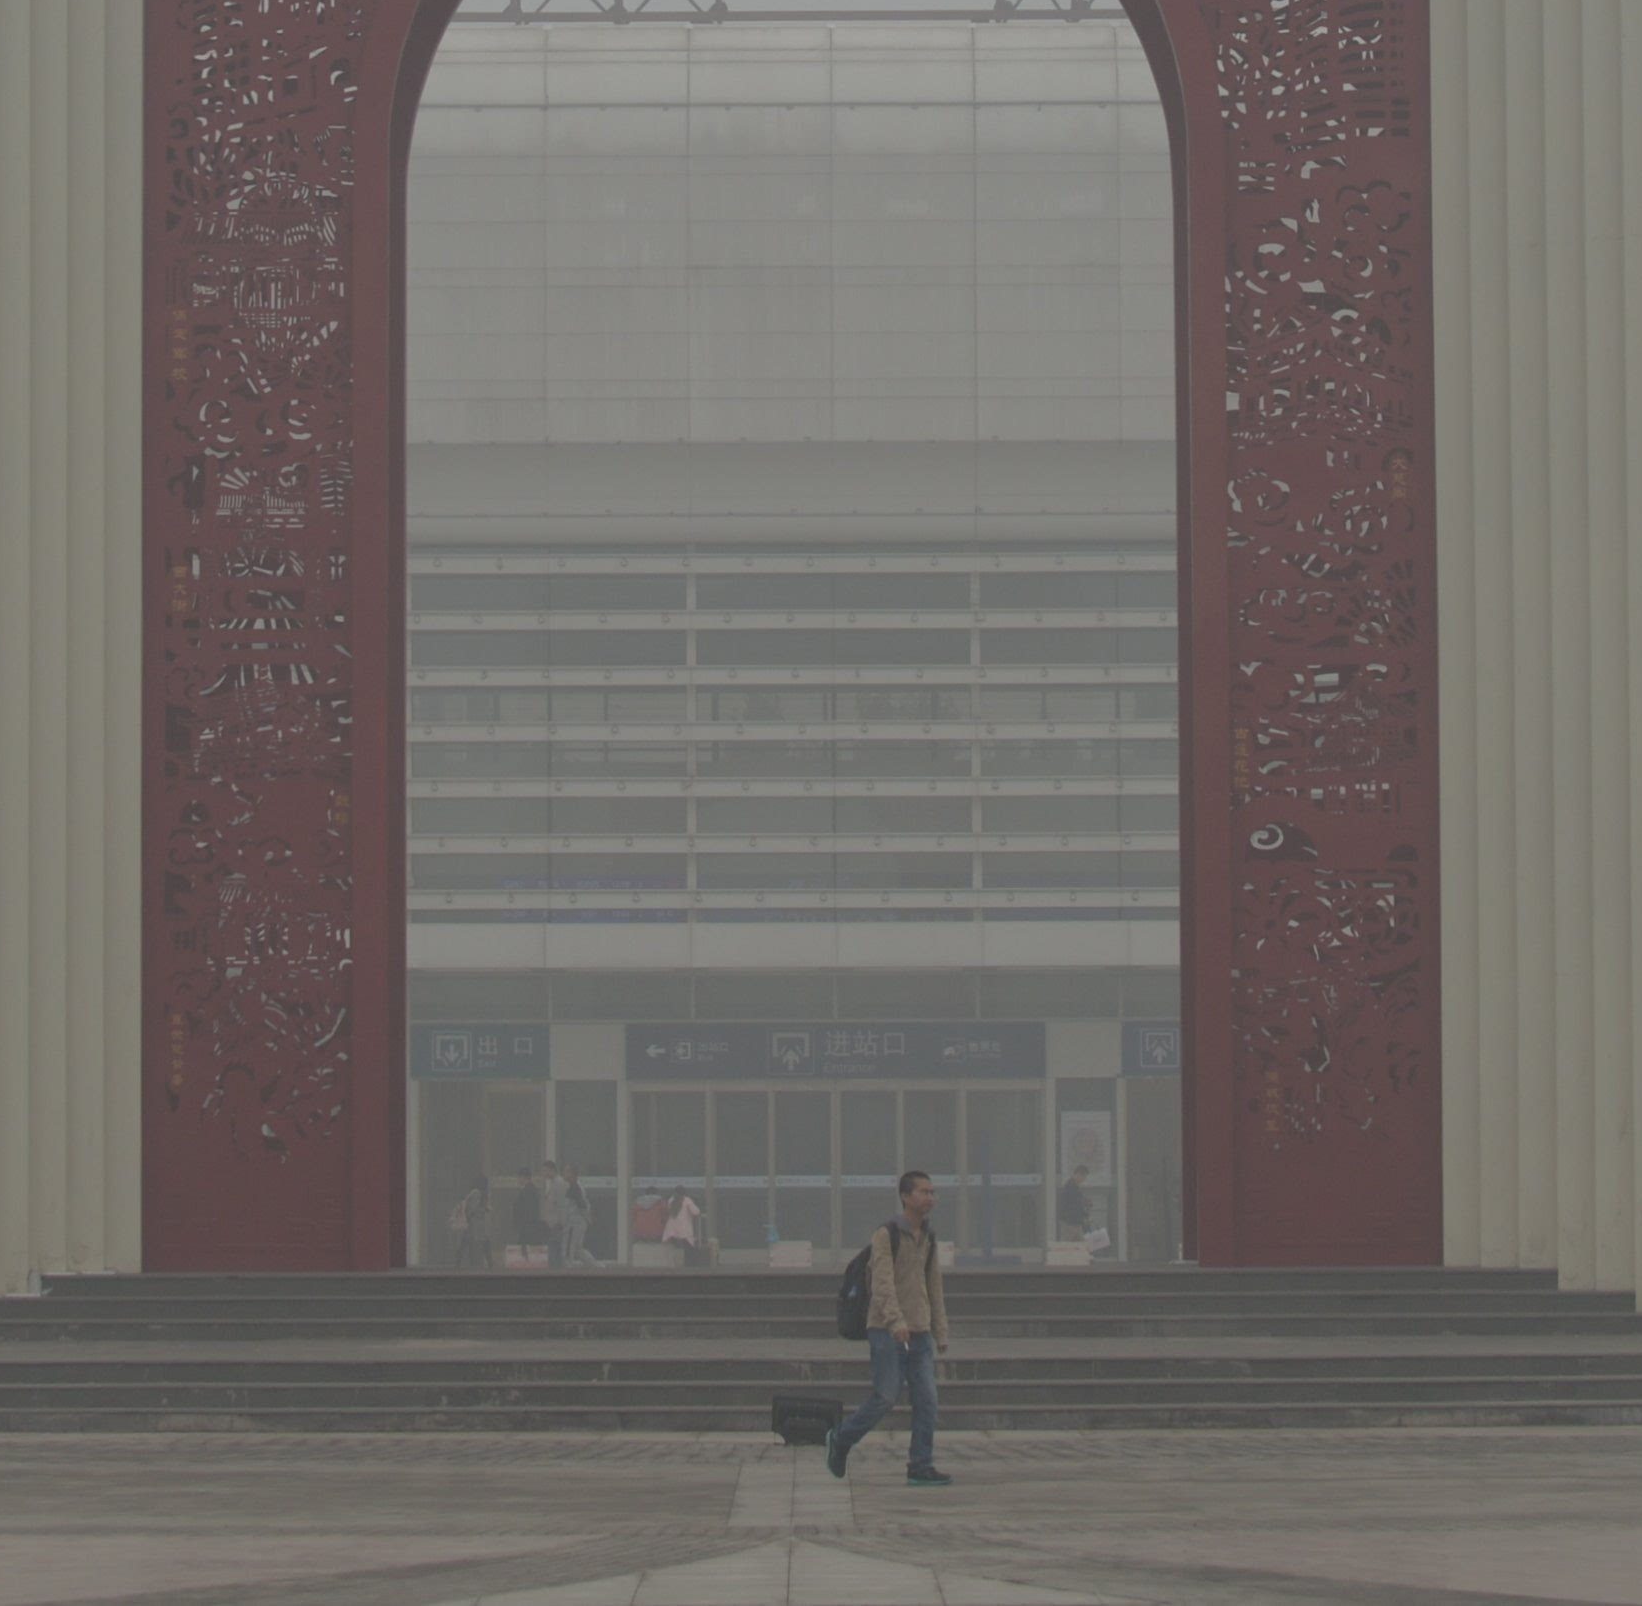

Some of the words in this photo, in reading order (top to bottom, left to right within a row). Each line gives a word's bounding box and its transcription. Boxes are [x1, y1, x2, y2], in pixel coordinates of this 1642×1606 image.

[477, 1037, 533, 1055] 出口
[824, 1029, 905, 1056] 进站口
